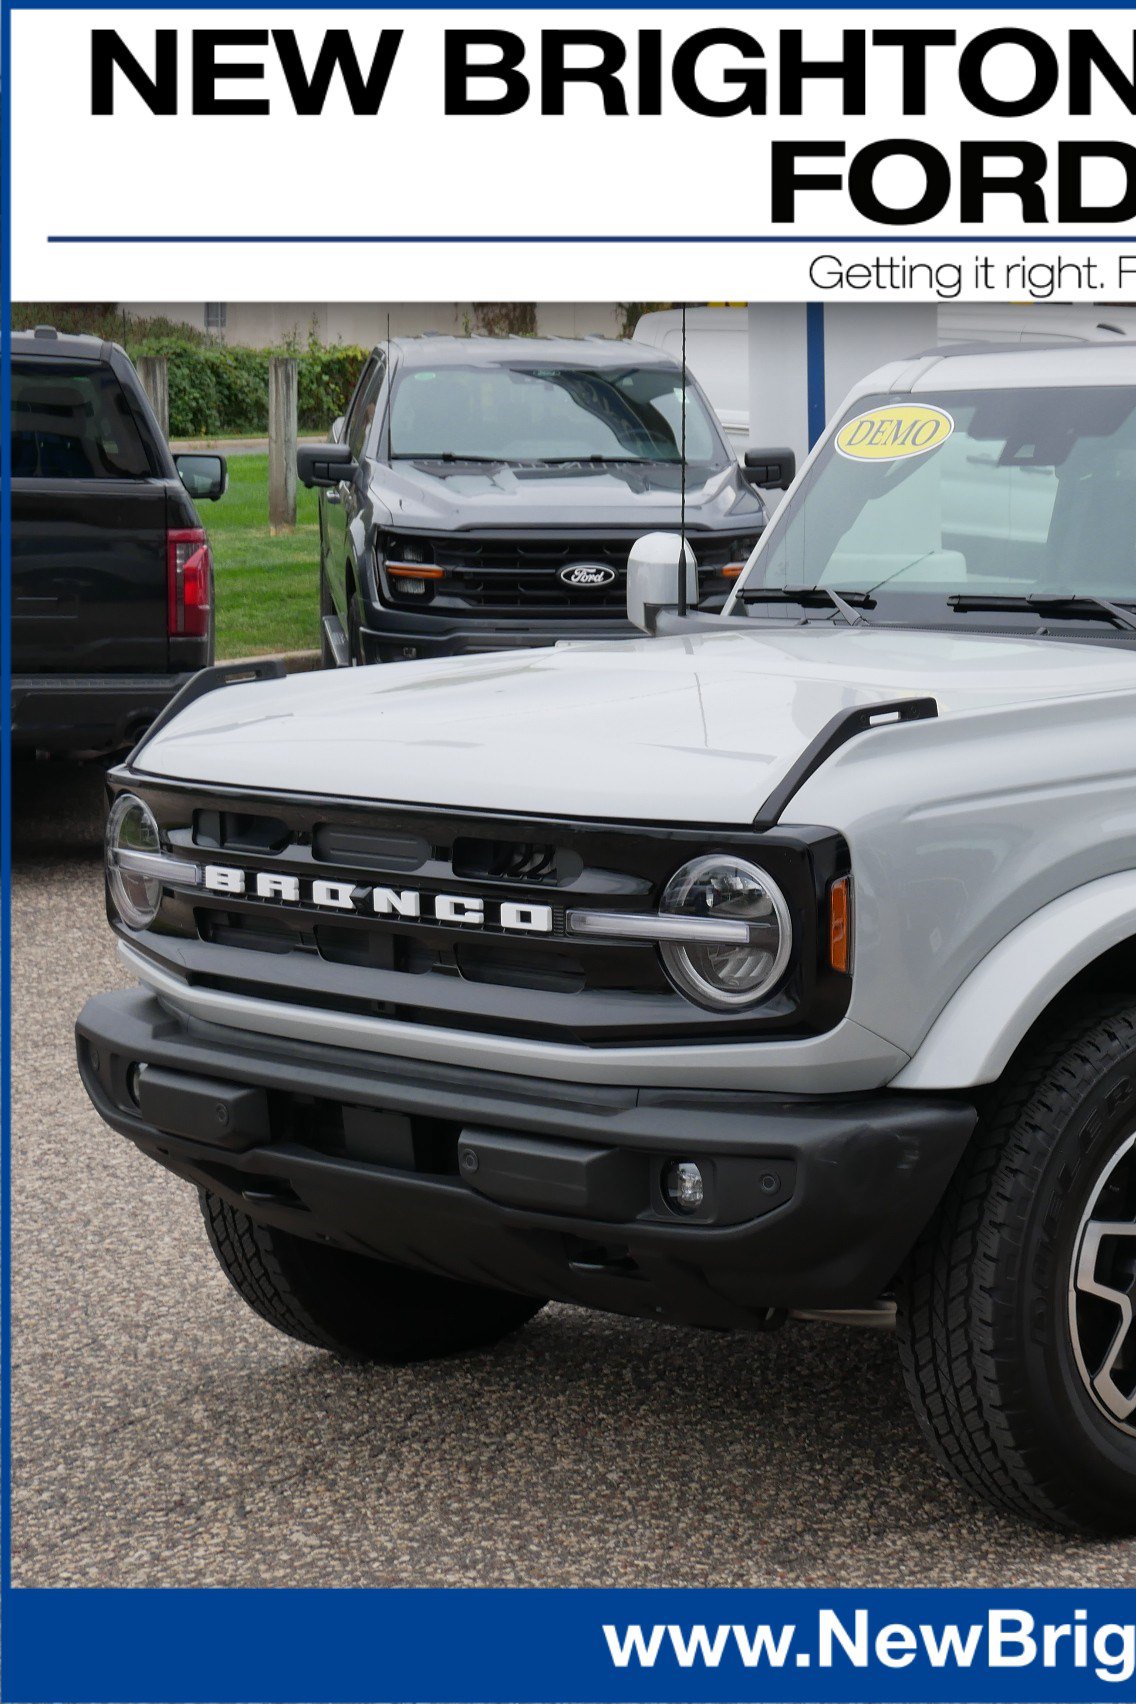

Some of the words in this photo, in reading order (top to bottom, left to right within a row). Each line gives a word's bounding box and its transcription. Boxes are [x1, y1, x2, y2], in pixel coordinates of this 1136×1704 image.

[846, 418, 941, 447] DEMO
[571, 568, 605, 583] Ford
[205, 865, 552, 932] BRONCO
